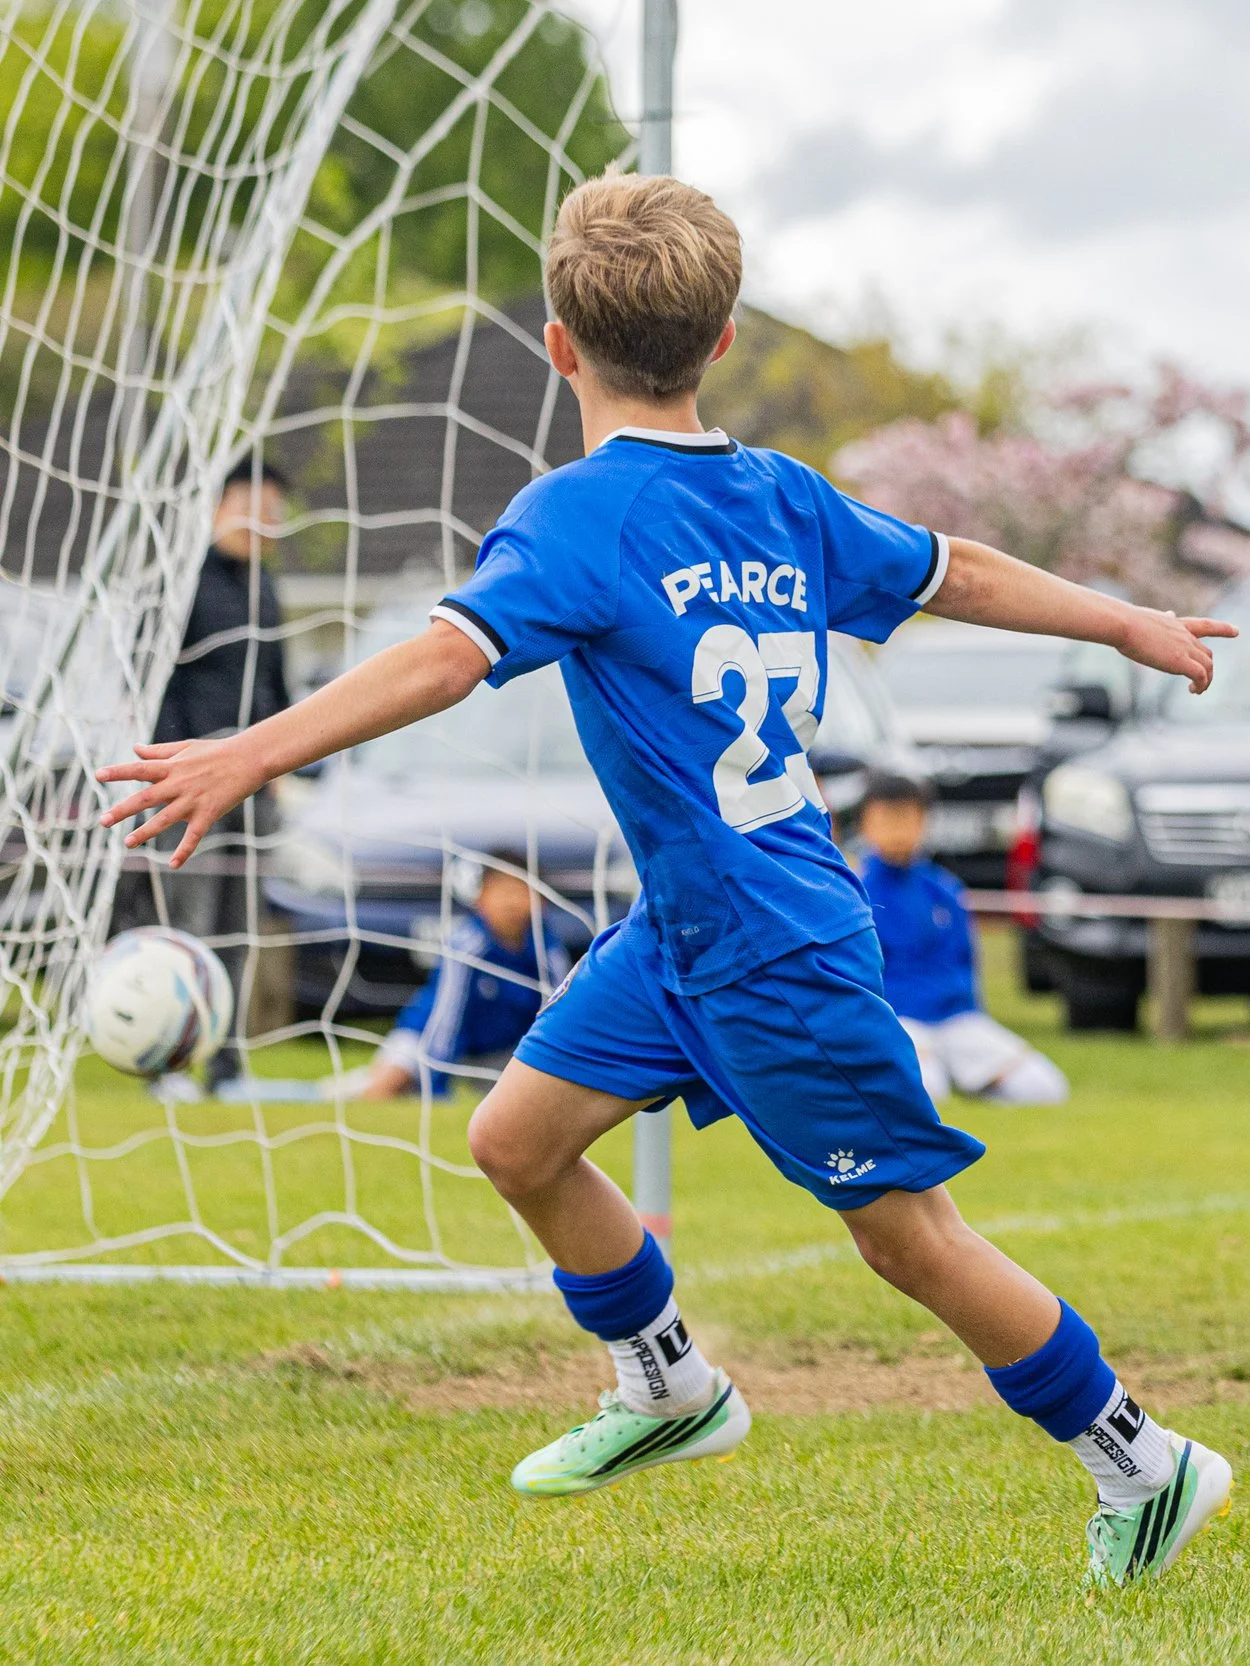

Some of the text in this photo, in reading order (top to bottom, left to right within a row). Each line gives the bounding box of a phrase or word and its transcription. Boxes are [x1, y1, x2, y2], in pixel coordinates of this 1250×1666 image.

[660, 560, 808, 618] PEARCE
[692, 624, 828, 835] 27
[828, 1158, 878, 1186] KELME
